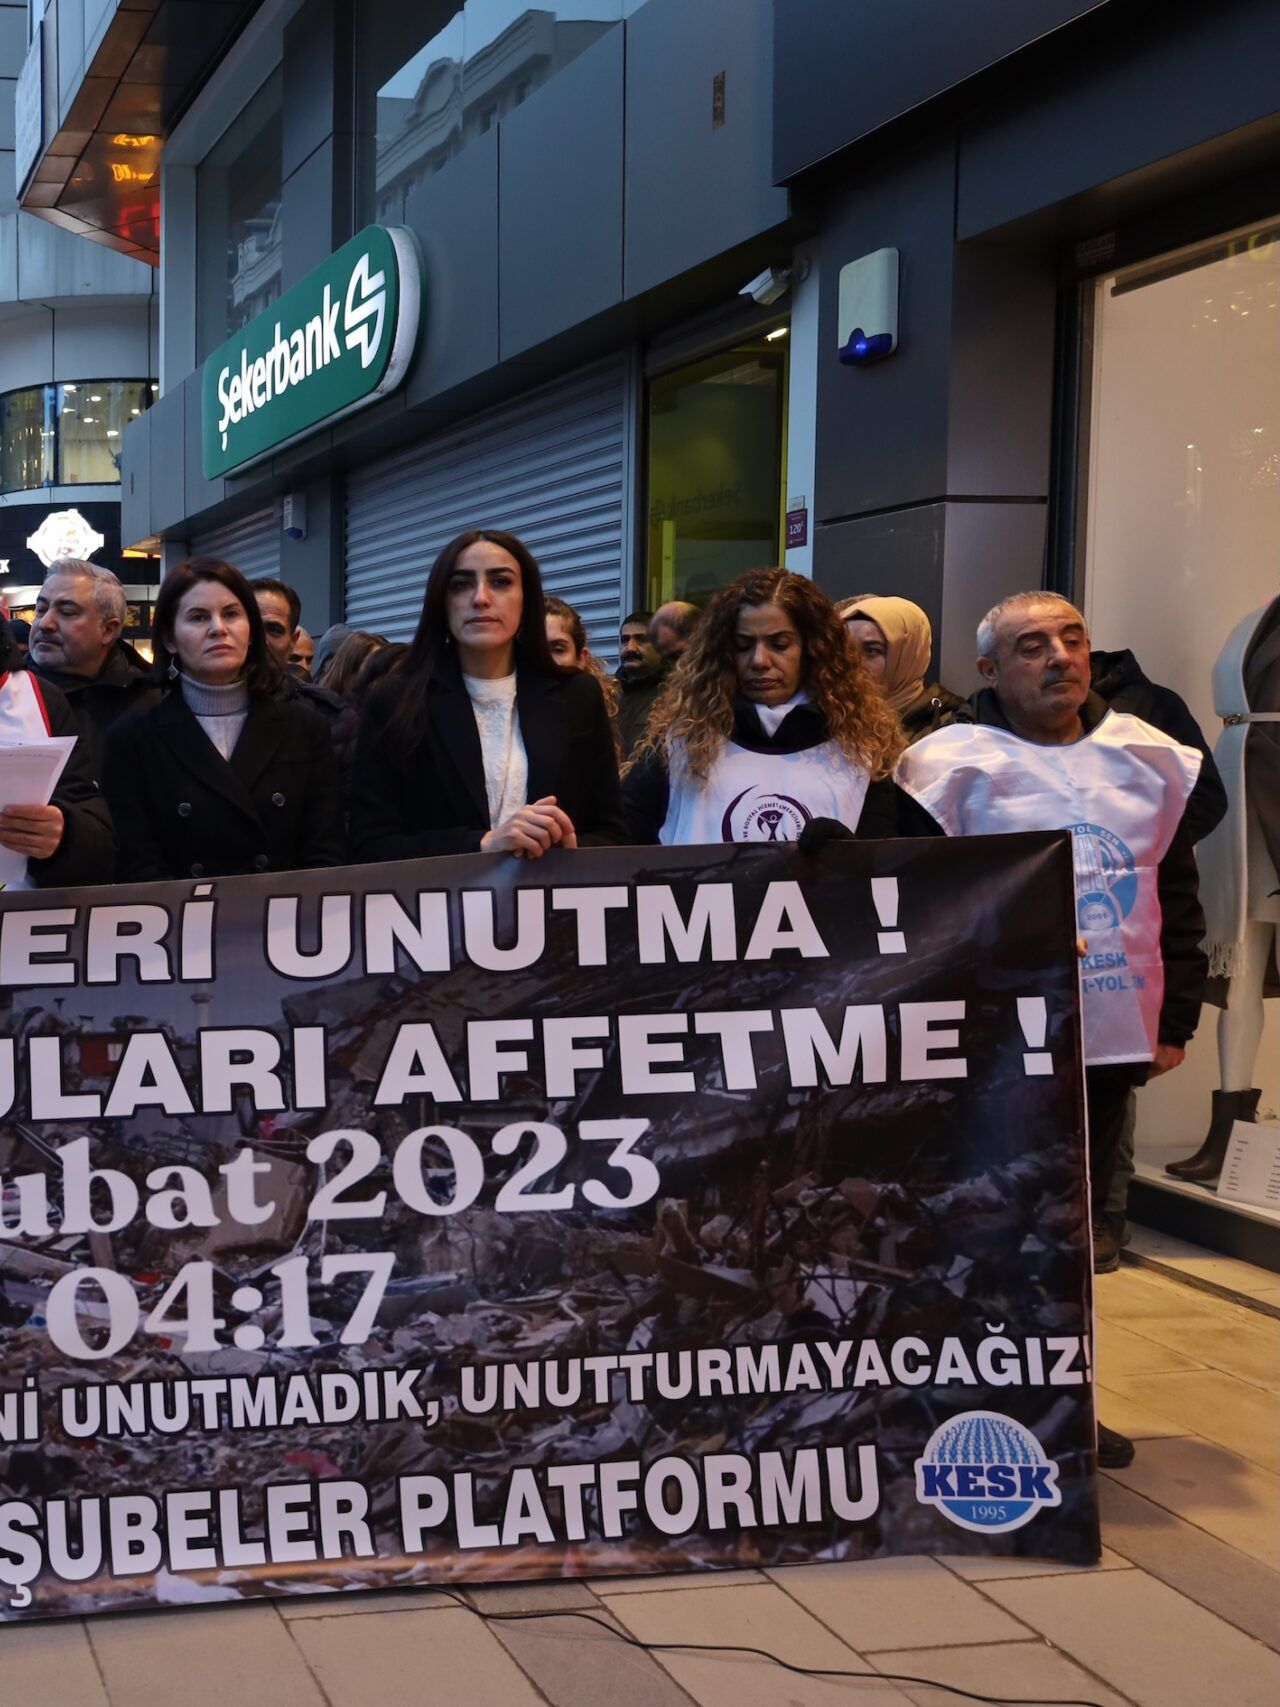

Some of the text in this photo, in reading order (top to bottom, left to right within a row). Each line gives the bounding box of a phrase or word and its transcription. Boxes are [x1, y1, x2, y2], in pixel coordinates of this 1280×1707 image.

[217, 282, 342, 452] Şekerbank
[266, 879, 830, 980] UNUTMA
[869, 877, 908, 955] !
[373, 1000, 968, 1104] AFFETME
[1016, 996, 1054, 1076] !
[306, 1117, 661, 1220] 2023
[45, 1251, 396, 1361] 04:17
[61, 1369, 440, 1438] UNUTMADIK,
[399, 1444, 881, 1553] PLATFORMU
[922, 1464, 1054, 1499] KESK
[970, 1505, 1007, 1521] 1995
